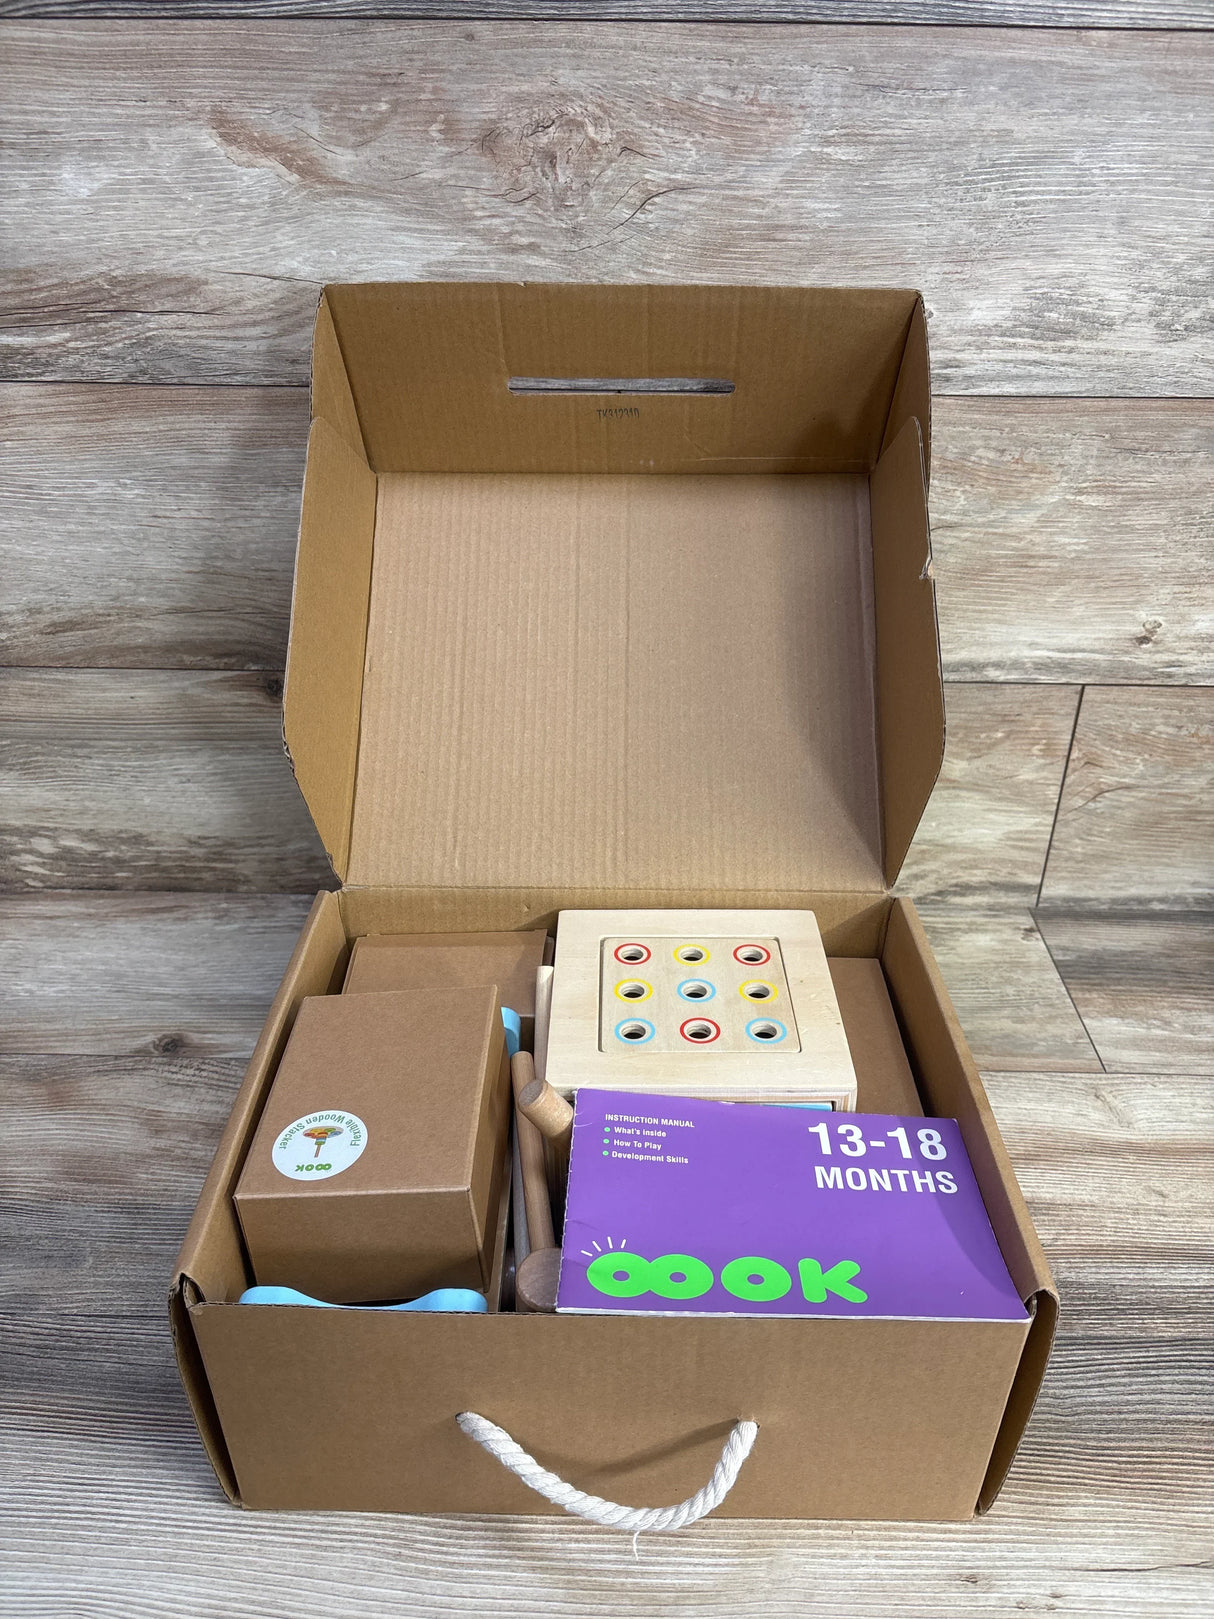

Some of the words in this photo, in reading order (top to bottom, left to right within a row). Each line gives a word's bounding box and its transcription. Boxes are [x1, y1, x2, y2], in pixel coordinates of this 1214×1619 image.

[306, 1114, 346, 1125] Wooden
[605, 1114, 659, 1125] INSTRUCTION
[661, 1118, 695, 1128] MANUAL
[279, 1122, 305, 1150] Stacker
[345, 1119, 362, 1147] Flexible
[614, 1127, 641, 1136] What's
[613, 1139, 631, 1147] How
[644, 1142, 662, 1151] Play
[808, 1122, 947, 1161] 13-18
[611, 1151, 664, 1161] Development
[666, 1155, 689, 1164] Skills
[814, 1165, 959, 1195] MONTHS
